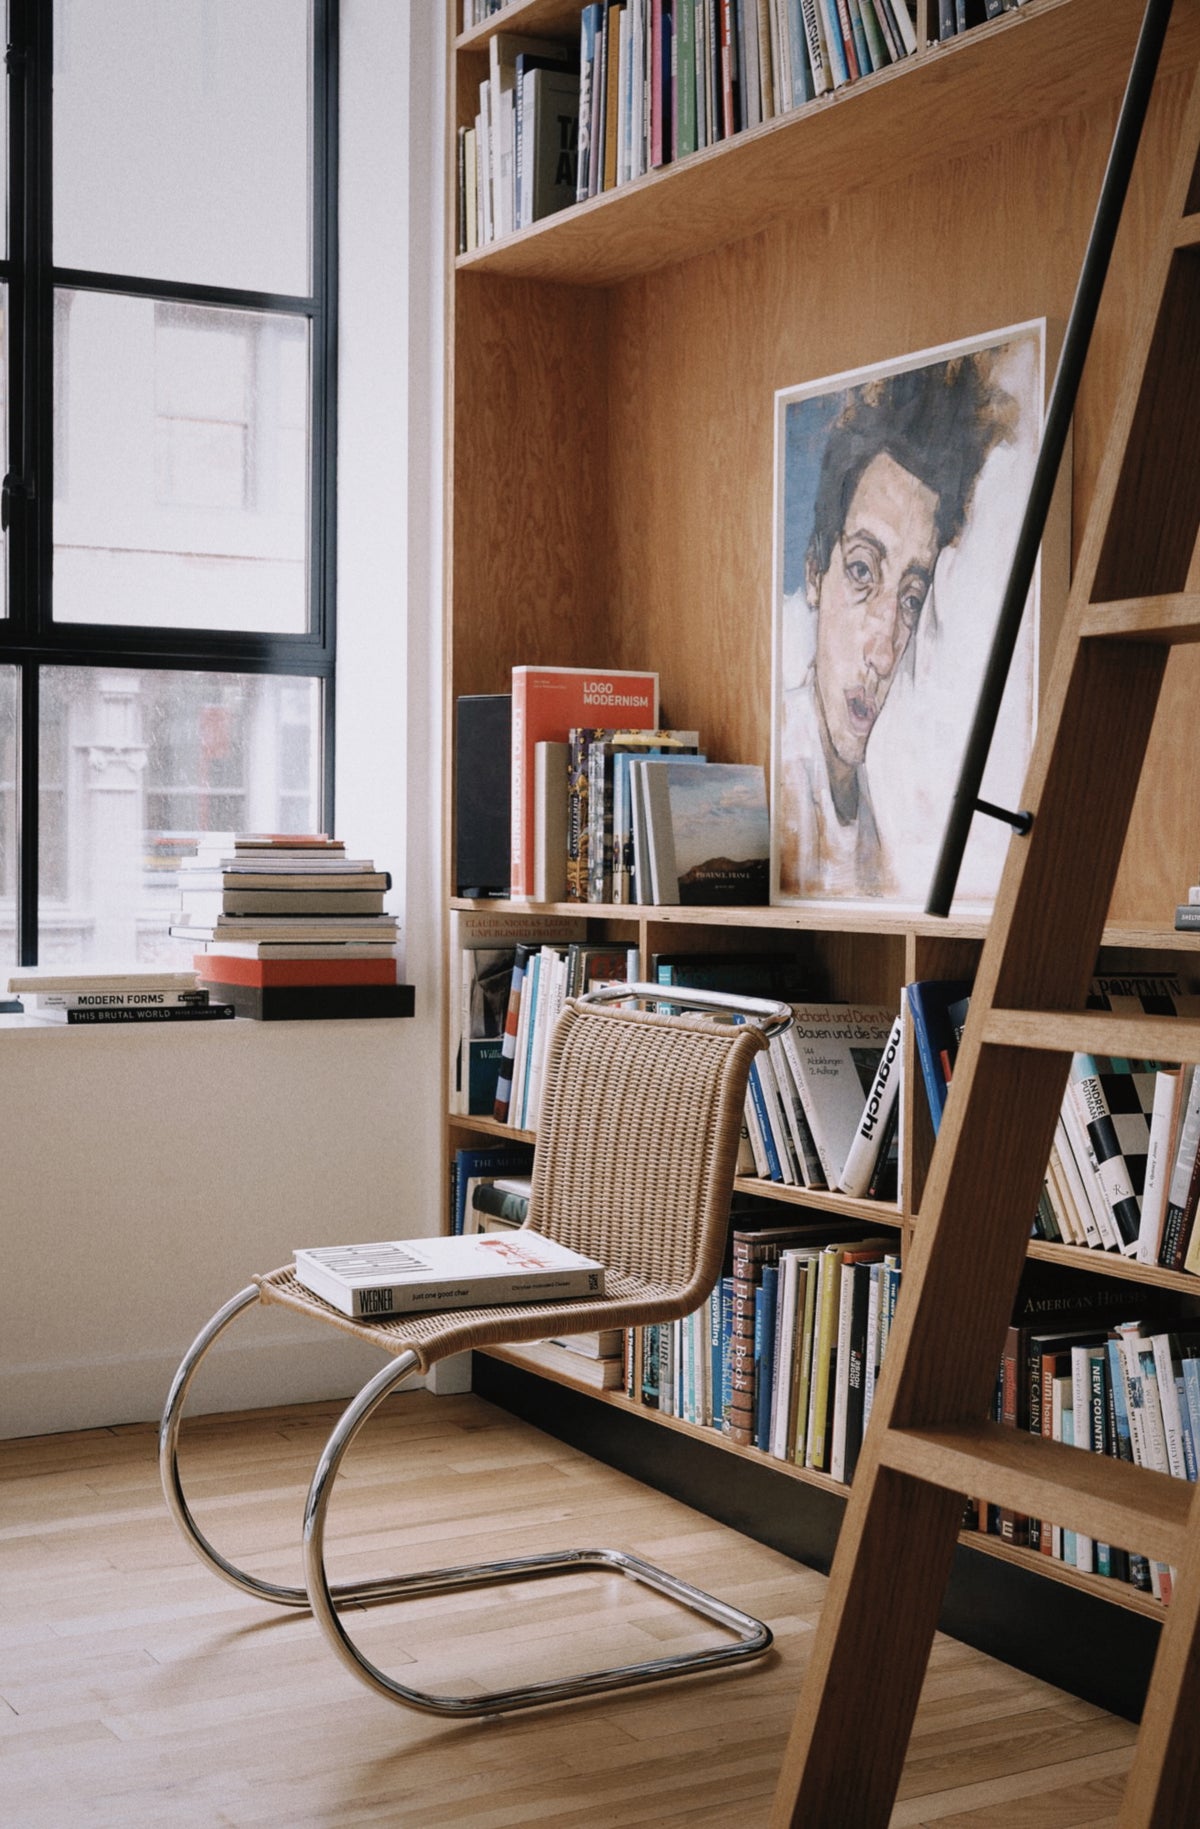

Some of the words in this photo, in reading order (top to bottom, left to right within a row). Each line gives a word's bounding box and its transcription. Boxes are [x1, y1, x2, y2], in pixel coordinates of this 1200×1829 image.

[583, 682, 613, 693] LOGO
[583, 694, 649, 707] MODERNISM
[78, 996, 124, 1005] MODERN
[127, 994, 165, 1004] FORMS
[73, 1012, 96, 1021] THIS
[99, 1011, 135, 1020] BRUTAL
[137, 1009, 171, 1018] WORLD
[832, 1009, 852, 1022] und
[797, 1026, 832, 1038] Bauen
[833, 1025, 853, 1039] und
[856, 1026, 870, 1039] die
[860, 1028, 901, 1142] noguchi
[1081, 1080, 1098, 1120] PUTMAN
[737, 1244, 749, 1278] The
[359, 1288, 393, 1314] WEGNER
[437, 1291, 454, 1300] good
[455, 1289, 470, 1297] chair
[736, 1284, 747, 1339] House
[735, 1345, 747, 1390] Book
[1031, 1356, 1040, 1383] THE
[1092, 1366, 1101, 1394] NEW
[1044, 1372, 1053, 1400] mini
[1031, 1384, 1040, 1427] CABIN
[1044, 1404, 1052, 1436] house
[1093, 1398, 1103, 1455] COUNTRY
